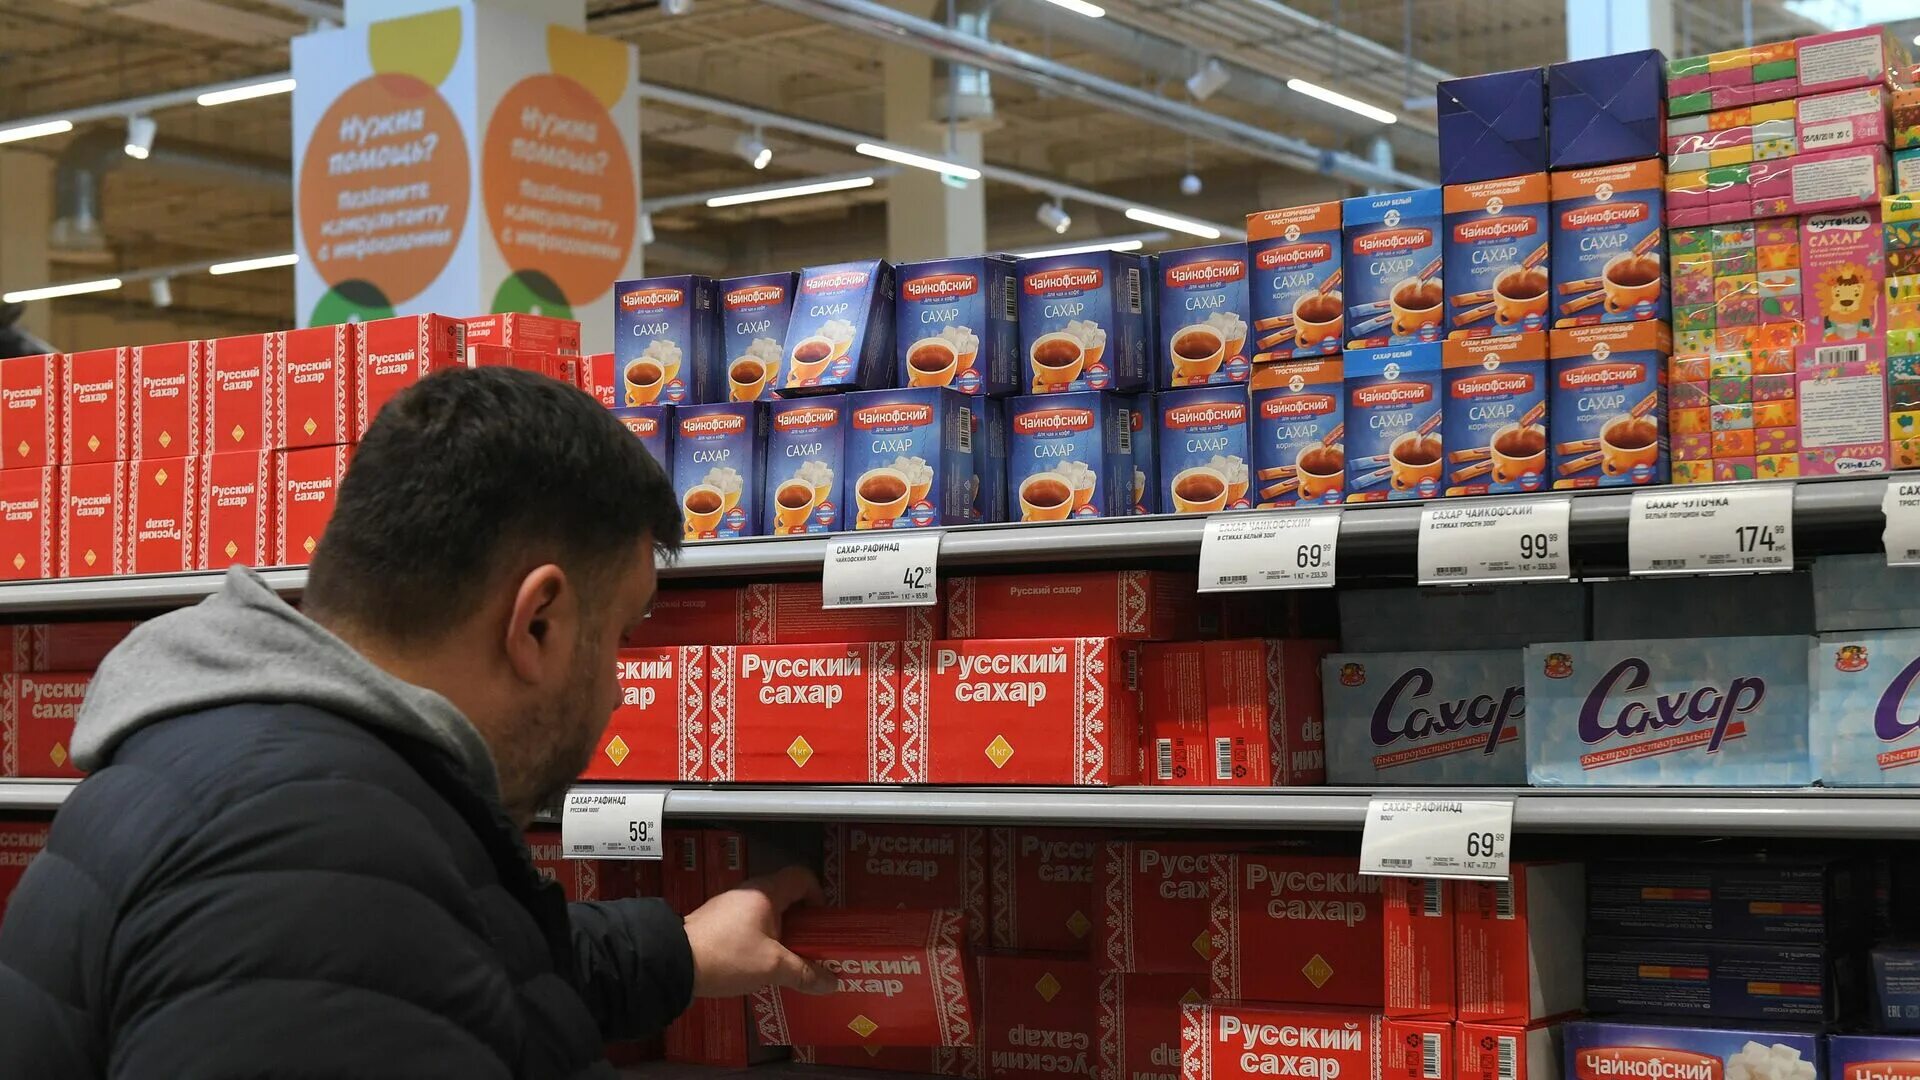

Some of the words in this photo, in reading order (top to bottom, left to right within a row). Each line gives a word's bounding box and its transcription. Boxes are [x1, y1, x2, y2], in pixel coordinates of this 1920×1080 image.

[339, 107, 425, 146] Нужна
[521, 104, 597, 144] Нужна
[328, 132, 439, 176] помощь?
[510, 137, 610, 176] помощь?
[1572, 171, 1593, 179] САХАР
[1464, 184, 1483, 193] САХАР
[1372, 200, 1391, 208] САХАР
[1392, 196, 1412, 206] БЕЛЫЙ
[1264, 212, 1282, 221] САХАР
[1568, 205, 1640, 226] Чайкофский
[1810, 215, 1869, 229] ЧУТОЧКА
[1461, 219, 1529, 238] Чайкофский
[1359, 231, 1425, 251] Чайкофский
[1580, 233, 1629, 252] САХАР
[1808, 232, 1862, 247] САХАР
[1262, 247, 1324, 265] Чайкофский
[1471, 247, 1518, 265] САХАР
[1171, 261, 1240, 284] Чайкофский
[1370, 259, 1414, 276] САХАР
[806, 272, 865, 289] Чайкофский
[908, 278, 972, 296] Чайкофский
[1029, 270, 1097, 290] Чайкофский
[1273, 272, 1315, 290] САХАР
[623, 290, 680, 306] Чайкофский
[727, 287, 781, 304] Чайкофский
[1185, 295, 1226, 311] САХАР
[810, 303, 848, 317] САХАР
[920, 309, 959, 324] САХАР
[1044, 303, 1084, 319] САХАР
[467, 318, 495, 330] усский
[467, 328, 490, 337] сахар
[633, 322, 669, 337] САХАР
[737, 320, 770, 335] САХАР
[368, 349, 415, 366] Русский
[1392, 349, 1413, 359] БЕЛЫЙ
[216, 366, 260, 382] Русский
[287, 358, 332, 375] Русский
[375, 362, 407, 375] сахар
[1566, 366, 1637, 384] Чайкофский
[143, 373, 185, 390] Русский
[222, 380, 253, 391] сахар
[294, 372, 325, 384] сахар
[1458, 377, 1526, 395] Чайкофский
[3, 384, 42, 401] Русский
[73, 379, 113, 395] Русский
[150, 386, 179, 398] сахар
[1359, 385, 1425, 403] Чайкофский
[8, 398, 37, 409] сахар
[79, 392, 107, 403] сахар
[1577, 394, 1626, 412] САХАР
[1171, 405, 1242, 425] Чайкофский
[1266, 398, 1328, 415] Чайкофский
[1469, 404, 1515, 421] САХАР
[778, 410, 834, 426] Чайкофский
[858, 407, 927, 425] Чайкофский
[1019, 412, 1089, 430] Чайкофский
[1369, 413, 1414, 429] САХАР
[683, 417, 742, 433] Чайкофский
[1276, 424, 1318, 440] САХАР
[786, 443, 822, 457] САХАР
[872, 439, 913, 453] САХАР
[1034, 444, 1075, 458] САХАР
[1186, 437, 1229, 453] САХАР
[693, 449, 730, 463] САХАР
[211, 483, 254, 497] Русский
[288, 477, 332, 492] Русский
[71, 494, 111, 508] Русский
[217, 496, 247, 507] сахар
[294, 490, 325, 501] сахар
[1646, 500, 1679, 510] САХАР
[1682, 497, 1729, 508] ЧУТОЧКА
[0, 498, 38, 511] Русский
[77, 506, 105, 517] сахар
[1432, 510, 1463, 520] САХАР
[1465, 506, 1533, 518] ЧАЙКОФСКИЙ
[5, 510, 33, 521] сахар
[145, 518, 175, 529] сахар
[1645, 512, 1668, 520] БЕЛЫЙ
[1669, 510, 1699, 519] ПОРЦИОН
[1435, 522, 1458, 530] СТИКАХ
[139, 529, 181, 543] Русский
[1735, 525, 1776, 552] 174
[1775, 525, 1785, 534] 99
[836, 542, 900, 555] САХАР-РАФИНАД
[1520, 533, 1548, 560] 99
[1548, 533, 1558, 542] 99
[1297, 544, 1321, 568] 69
[1322, 543, 1331, 552] 99
[903, 566, 925, 589] 42
[925, 566, 932, 574] 99
[1009, 585, 1051, 597] Русский
[1052, 586, 1082, 596] сахар
[651, 601, 680, 610] усский
[616, 655, 673, 679] ский
[741, 651, 862, 684] Русский
[936, 646, 1068, 680] Русский
[21, 677, 91, 702] Русски
[623, 686, 656, 710] хар
[758, 684, 843, 708] сахар
[955, 681, 1047, 708] сахар
[1371, 667, 1526, 755] Сахар
[1578, 656, 1766, 754] Сахар
[1581, 727, 1714, 765] Быстрорастворимый
[571, 796, 627, 806] САХАР-РАФИНАД
[1382, 802, 1463, 813] САХАР-РАФИНАД
[629, 820, 648, 842] 59
[647, 821, 654, 829] 99
[850, 830, 954, 857] Русский
[1467, 832, 1495, 858] 69
[1495, 833, 1505, 842] 99
[866, 857, 938, 881] сахар
[1139, 849, 1209, 878] Русс
[1246, 864, 1384, 897] Русский
[1159, 880, 1210, 900] сах
[1267, 899, 1367, 927] сахар
[823, 954, 922, 976] сский
[837, 978, 904, 997] ахар
[1008, 1023, 1089, 1050] сахар
[1219, 1014, 1363, 1051] Русский
[1239, 1052, 1341, 1080] сахар
[1586, 1056, 1713, 1080] Чайкофский
